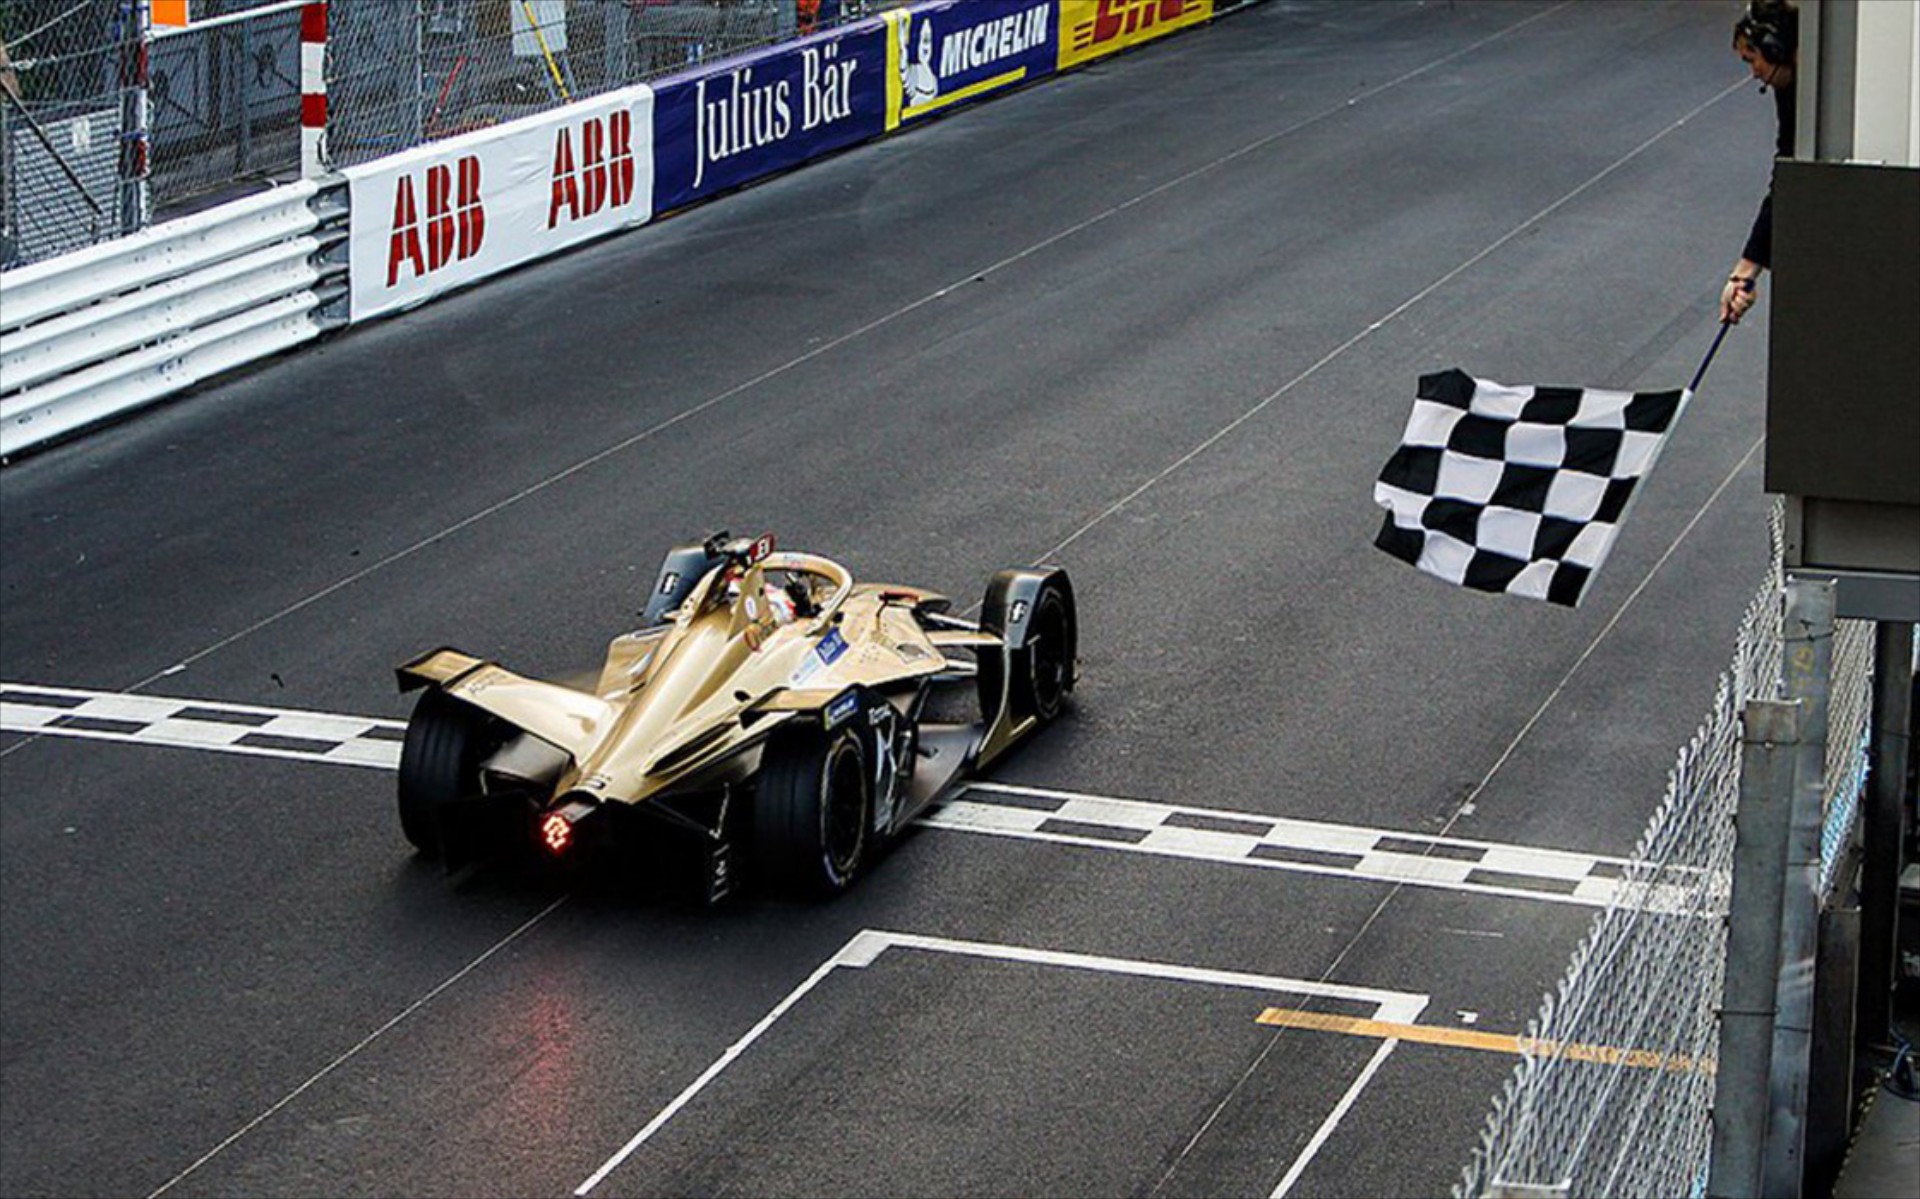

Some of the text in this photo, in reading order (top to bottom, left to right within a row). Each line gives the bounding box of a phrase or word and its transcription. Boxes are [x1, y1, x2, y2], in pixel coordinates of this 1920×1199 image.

[940, 3, 1049, 78] MICHELIN
[547, 109, 636, 230] ABB
[693, 42, 857, 188] Julius Bär
[386, 155, 485, 288] ABB
